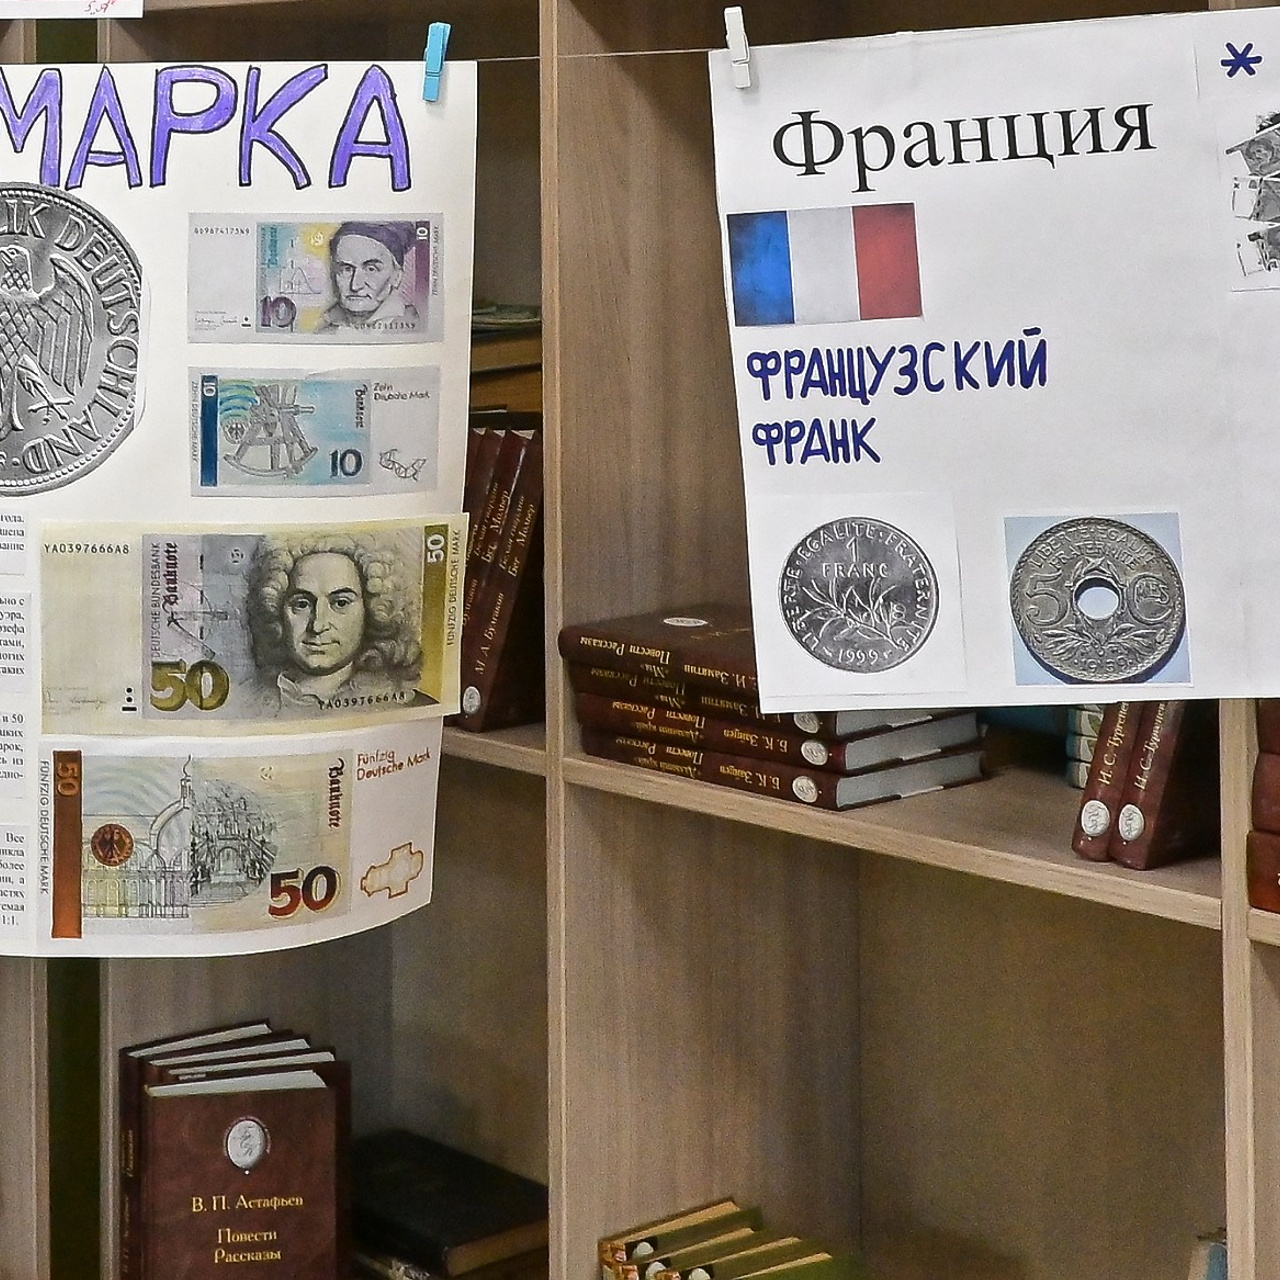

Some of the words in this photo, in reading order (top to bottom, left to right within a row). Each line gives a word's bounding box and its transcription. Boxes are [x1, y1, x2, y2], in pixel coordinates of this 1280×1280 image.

[771, 101, 1159, 194] Франция
[258, 294, 297, 329] 10
[745, 327, 1050, 406] ФРАНЦУЗСКИЙ
[750, 416, 882, 467] ФРАНК
[327, 447, 364, 478] 10
[43, 542, 130, 555] YA0397666A8
[847, 539, 859, 562] 1
[821, 562, 889, 578] FRANC
[1024, 573, 1069, 626] 5
[580, 636, 625, 656] Рассказы
[629, 645, 671, 665] Повести
[837, 648, 880, 665] 1999
[149, 659, 230, 712] 50
[356, 749, 396, 768] Fünfzig
[356, 762, 404, 782] Deutsche
[405, 748, 432, 769] Mark
[39, 759, 50, 806] FÜNFZIG
[38, 807, 50, 861] DEUTSCHE
[38, 863, 50, 895] MARK
[267, 865, 342, 918] 50
[192, 1196, 207, 1212] В.
[212, 1195, 230, 1211] П.
[235, 1194, 304, 1211] Астафьев
[218, 1228, 278, 1244] Повести
[214, 1247, 282, 1263] Рассказы
